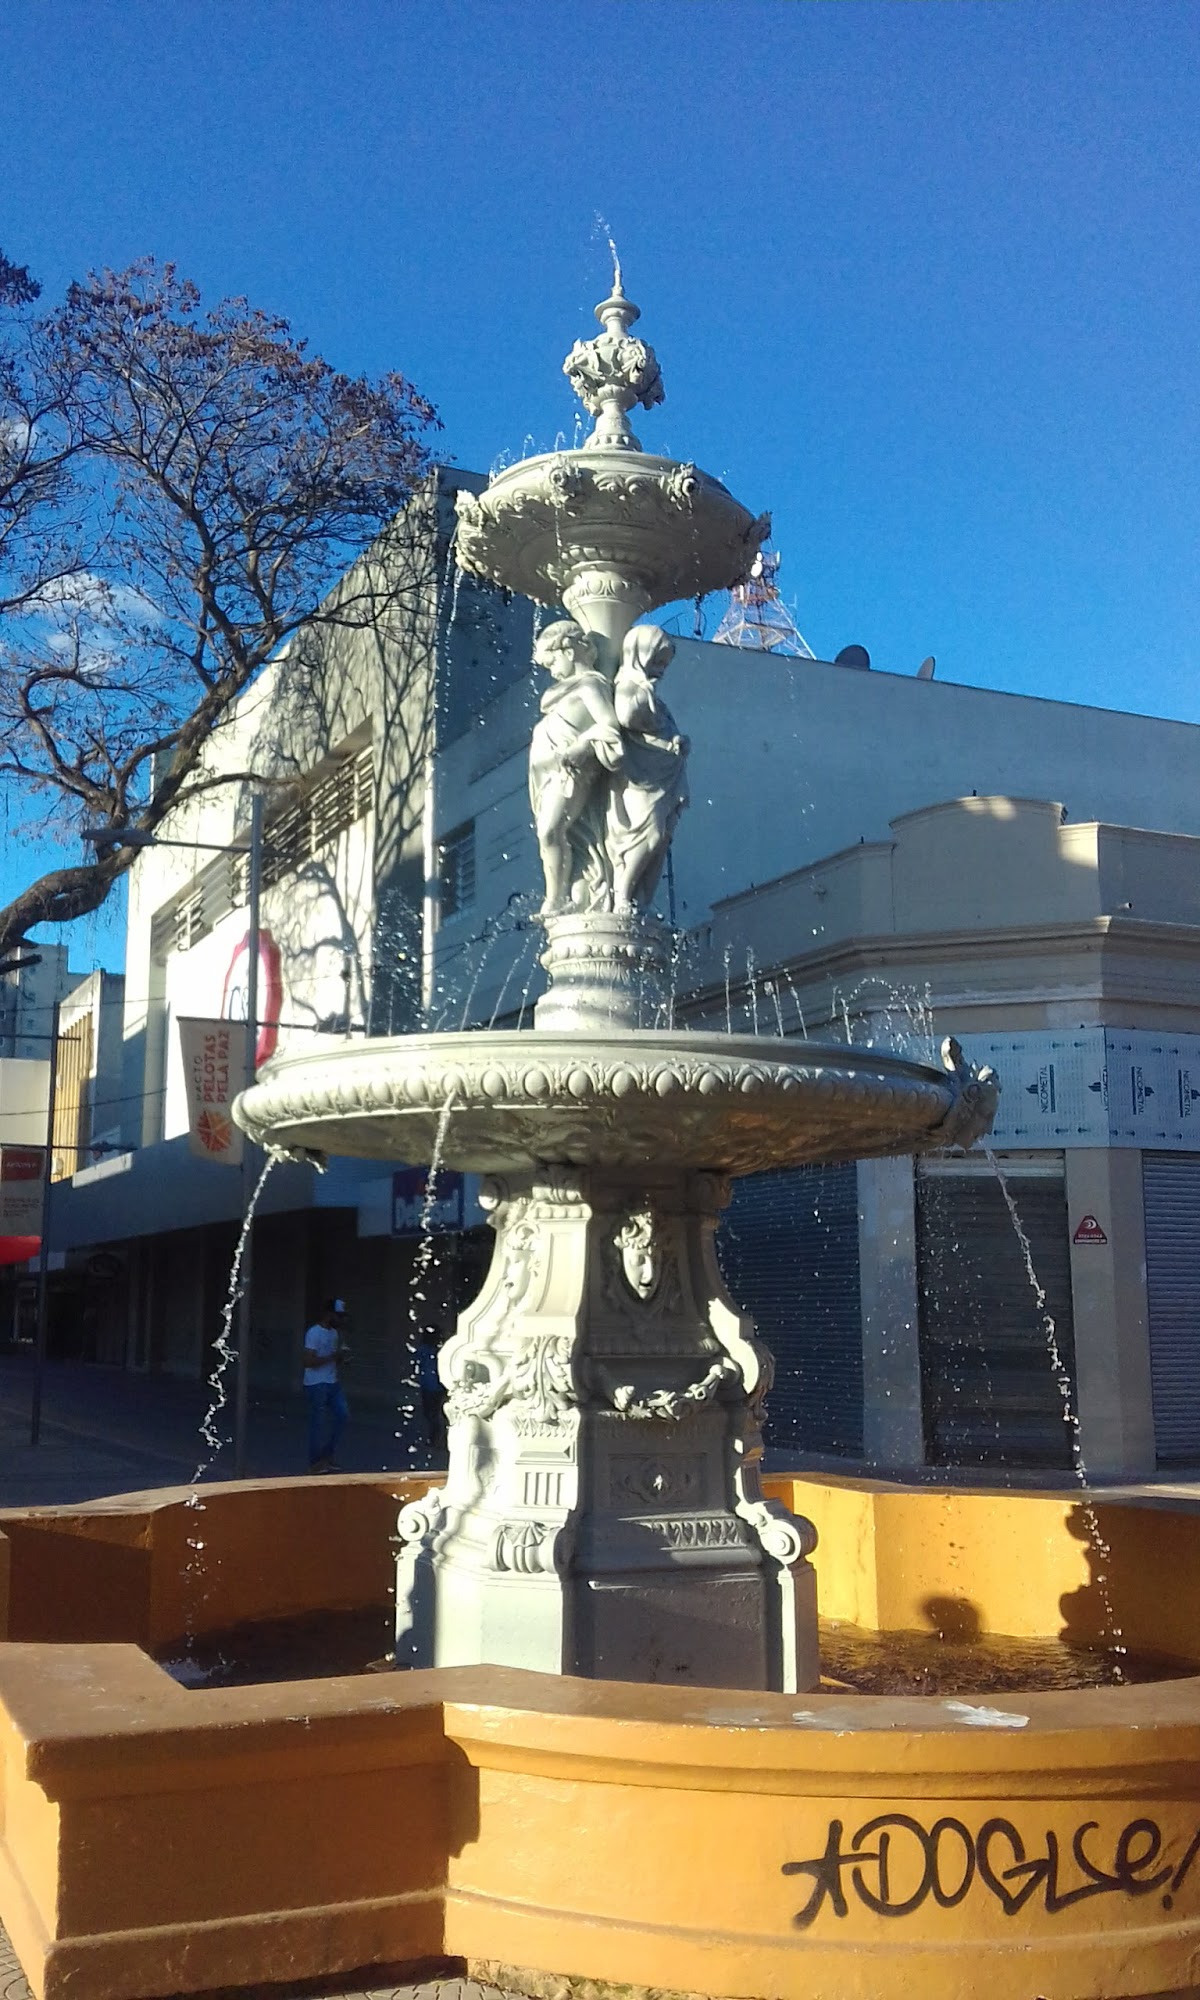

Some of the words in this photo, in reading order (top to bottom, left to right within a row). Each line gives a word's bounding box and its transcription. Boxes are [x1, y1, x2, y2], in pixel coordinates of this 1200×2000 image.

[218, 1030, 229, 1059] PAZ
[204, 1035, 216, 1103] PELOTAS
[217, 1065, 229, 1103] PELA
